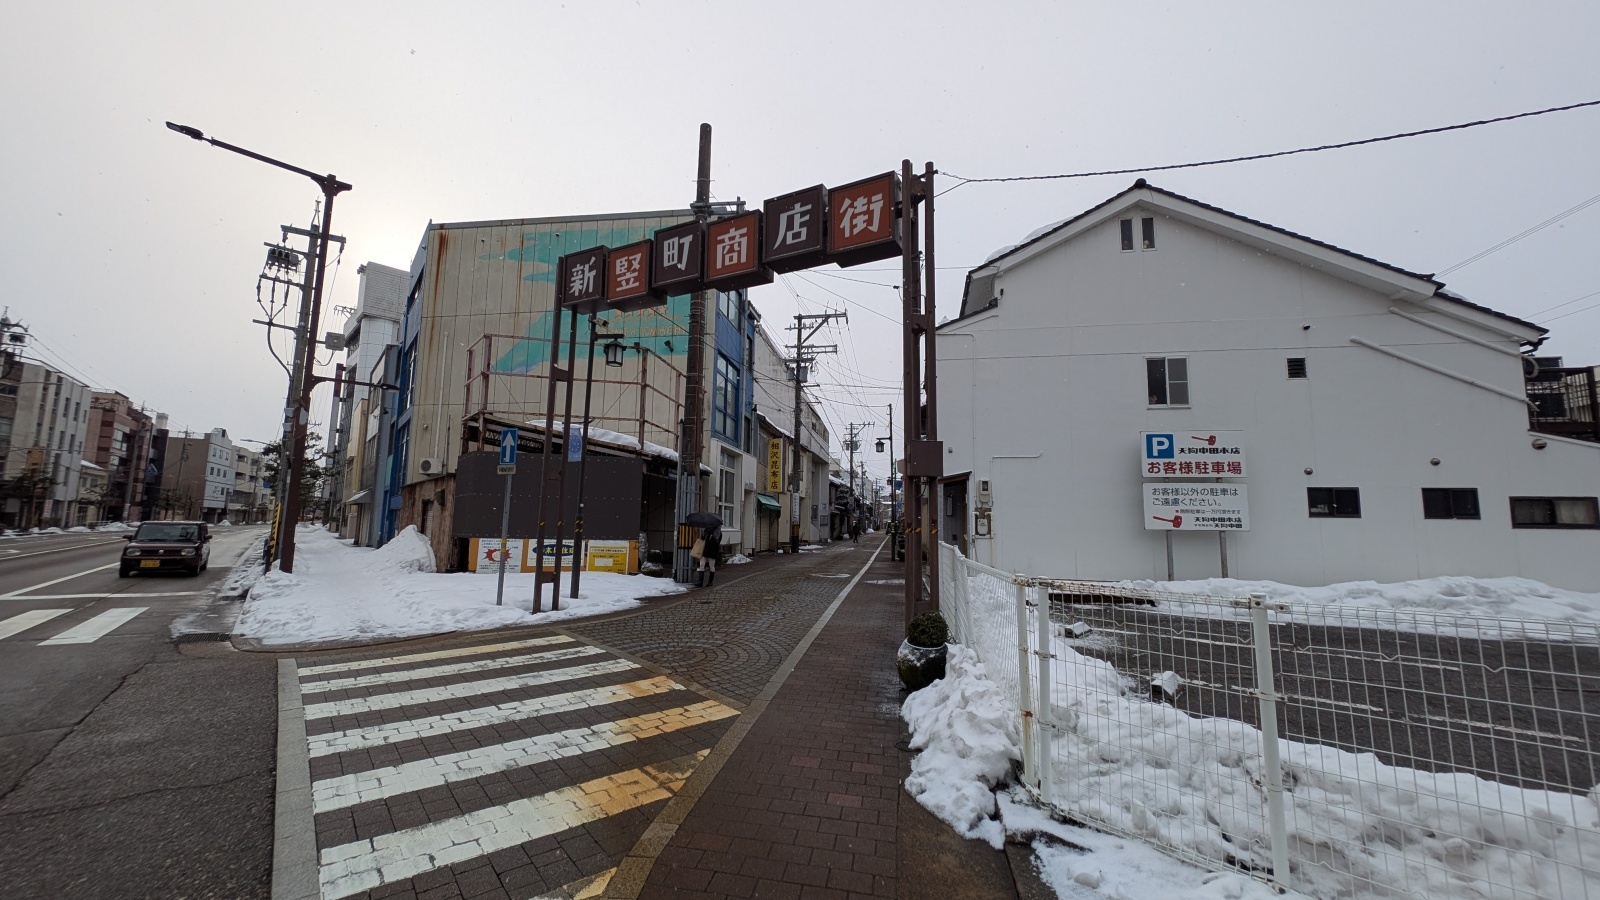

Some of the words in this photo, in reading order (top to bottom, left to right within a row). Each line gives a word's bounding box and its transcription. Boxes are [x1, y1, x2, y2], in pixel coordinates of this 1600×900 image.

[569, 193, 884, 297] 新竪町商店街
[1152, 437, 1170, 456] P
[1178, 447, 1241, 455] 天狗中田本店
[770, 442, 780, 490] 相沢昆布店
[1147, 461, 1242, 475] お客様駐車場
[1151, 487, 1239, 497] お客様以外の駐車は
[1152, 498, 1222, 506] ご遠慮ください。
